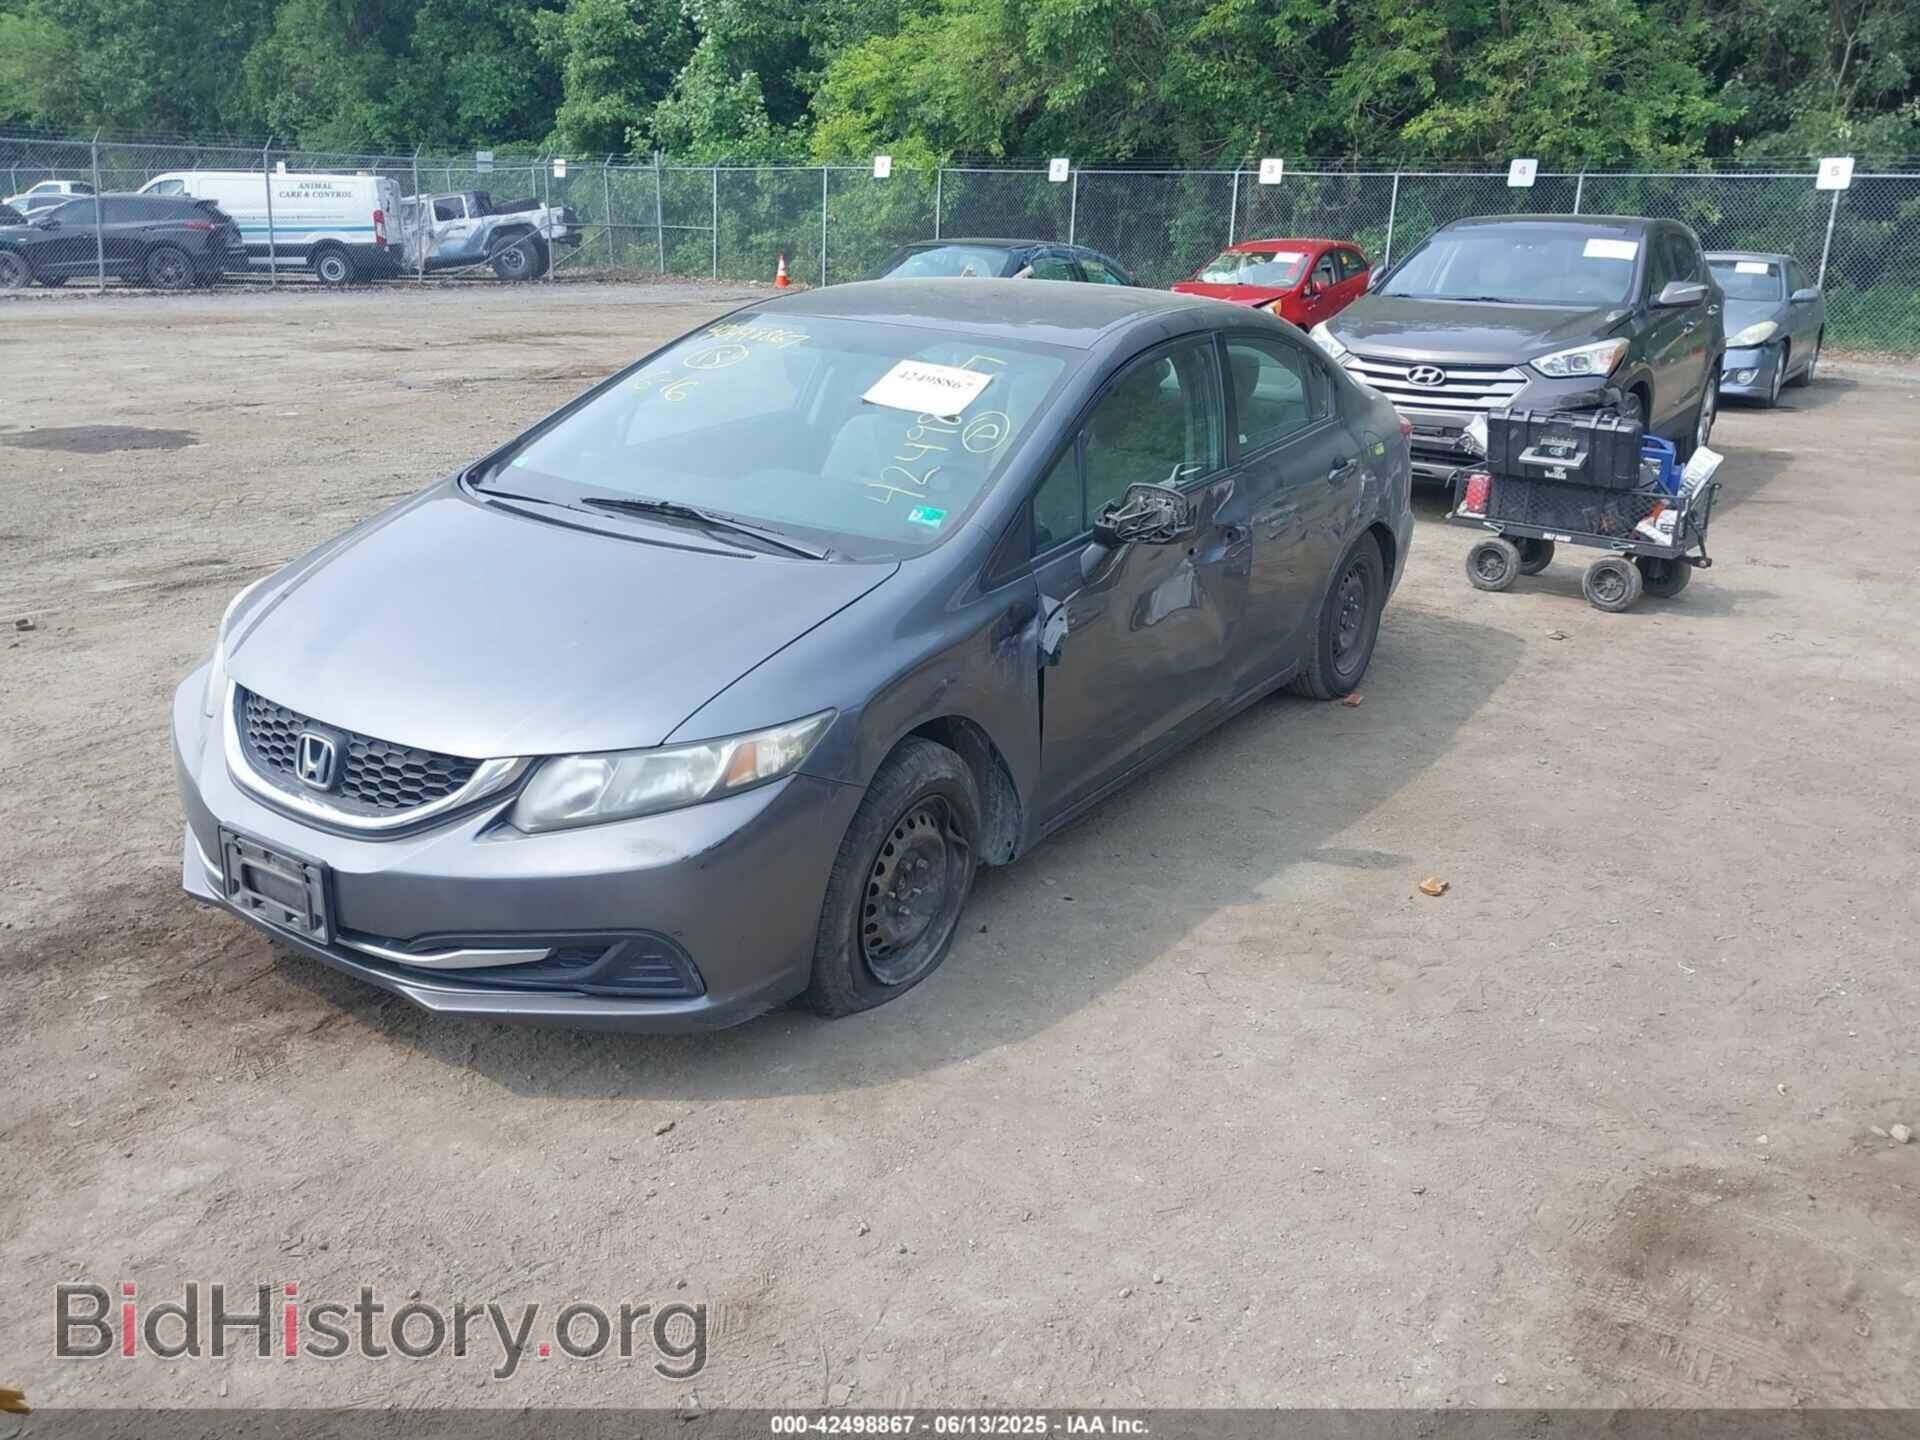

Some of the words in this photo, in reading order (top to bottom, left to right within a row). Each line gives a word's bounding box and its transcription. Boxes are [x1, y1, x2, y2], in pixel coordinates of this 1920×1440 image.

[1265, 164, 1276, 175] 3
[1519, 165, 1528, 176] 4
[1830, 165, 1840, 177] 5
[279, 191, 301, 199] CARE
[304, 191, 310, 199] &
[312, 191, 353, 199] CONTROL
